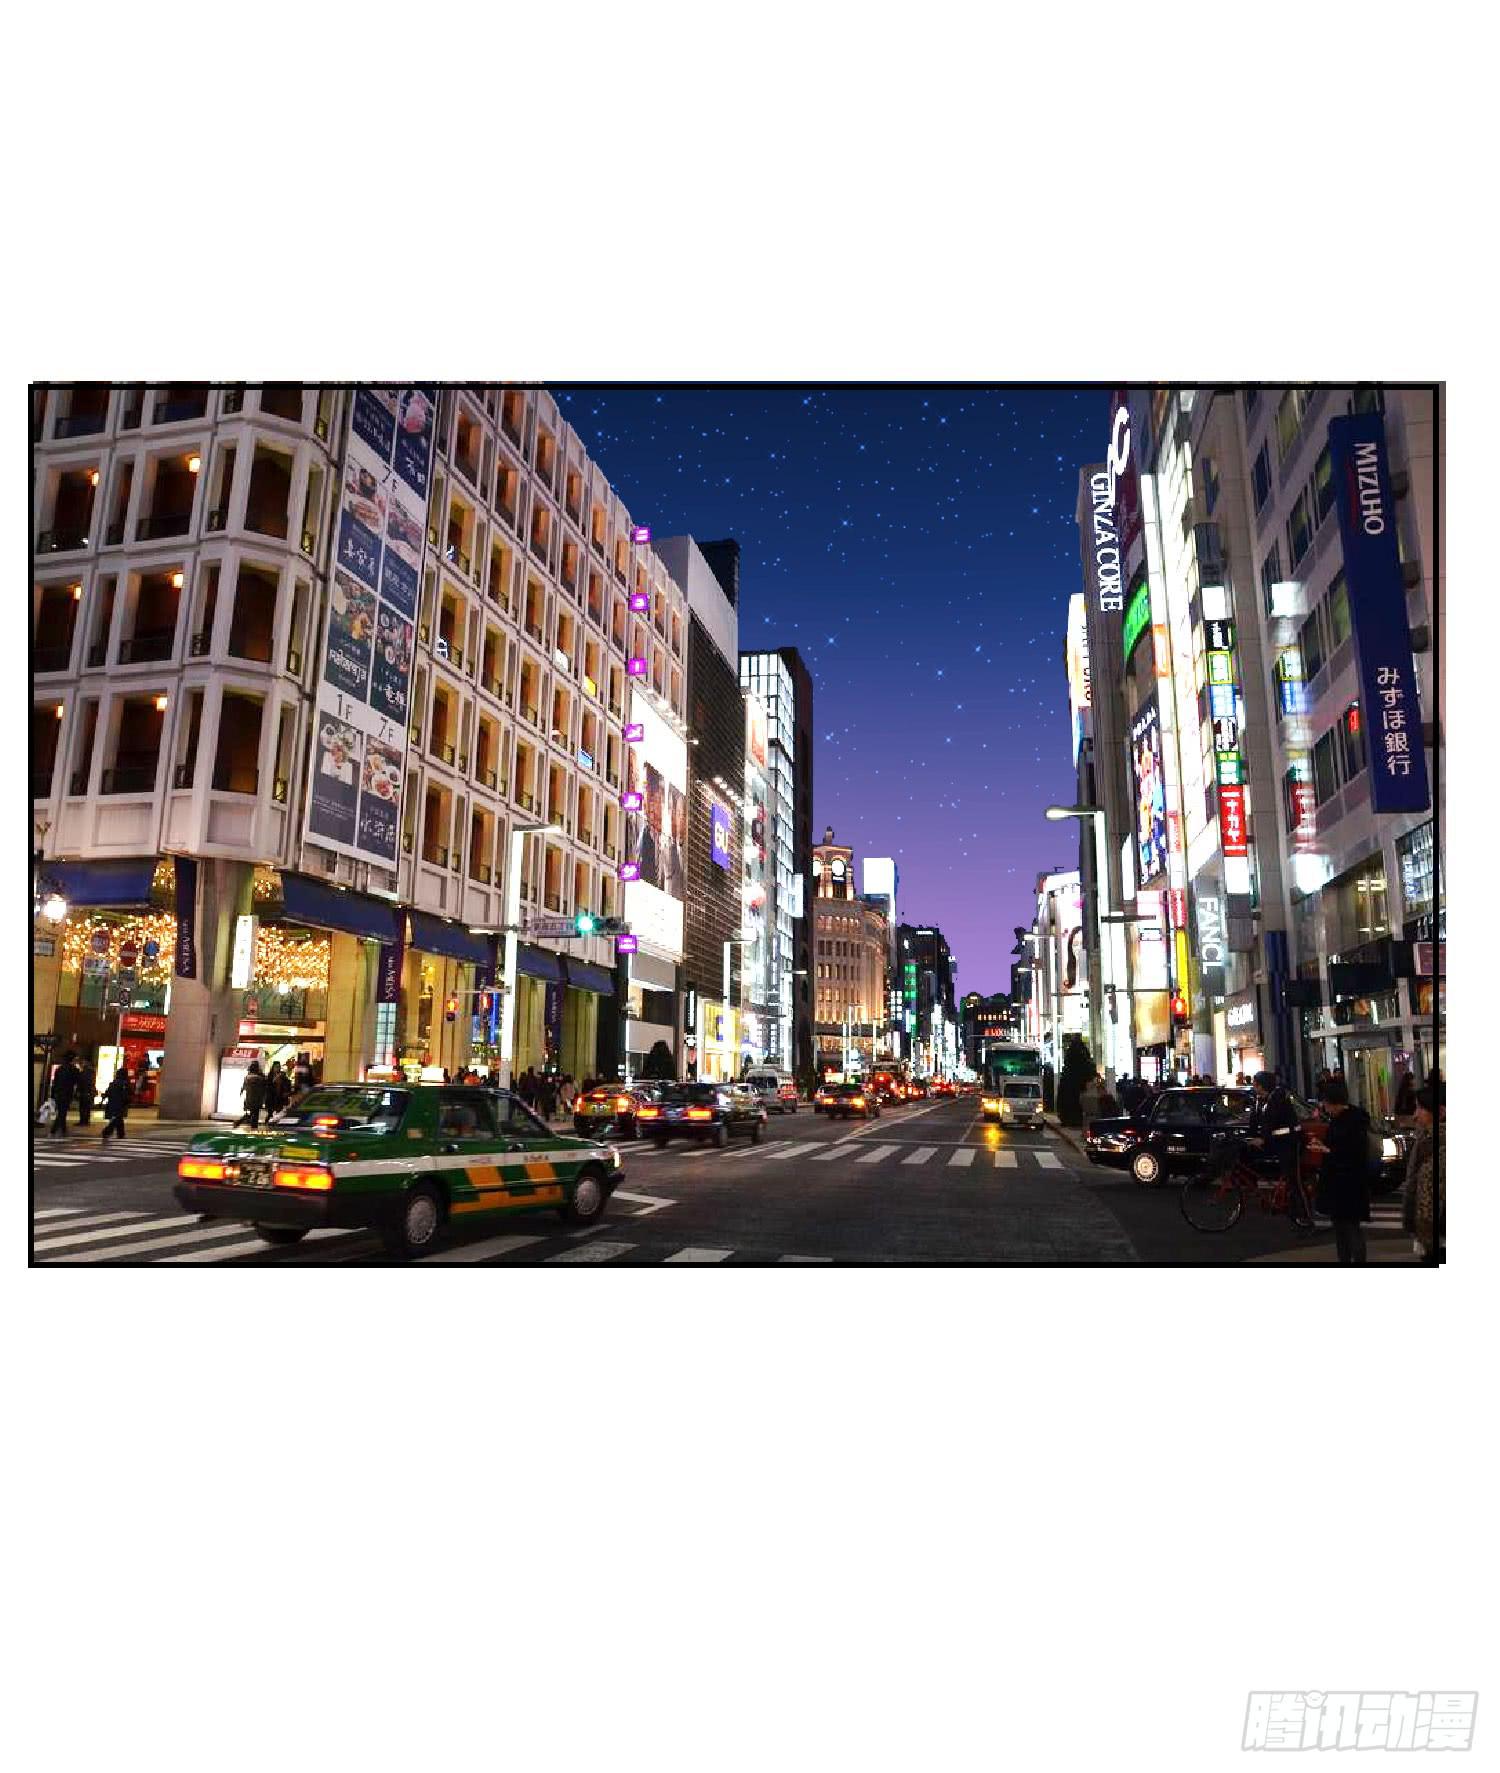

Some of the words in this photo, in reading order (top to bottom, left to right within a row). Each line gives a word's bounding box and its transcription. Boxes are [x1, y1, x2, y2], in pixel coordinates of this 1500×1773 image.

[1091, 472, 1119, 545] GINZA
[1353, 442, 1385, 536] MIZUHO
[1096, 547, 1124, 612] CORE
[337, 693, 354, 720] 1F
[1376, 666, 1413, 776] みずほ銀行
[714, 820, 729, 854] GU
[1198, 897, 1225, 975] FANCL
